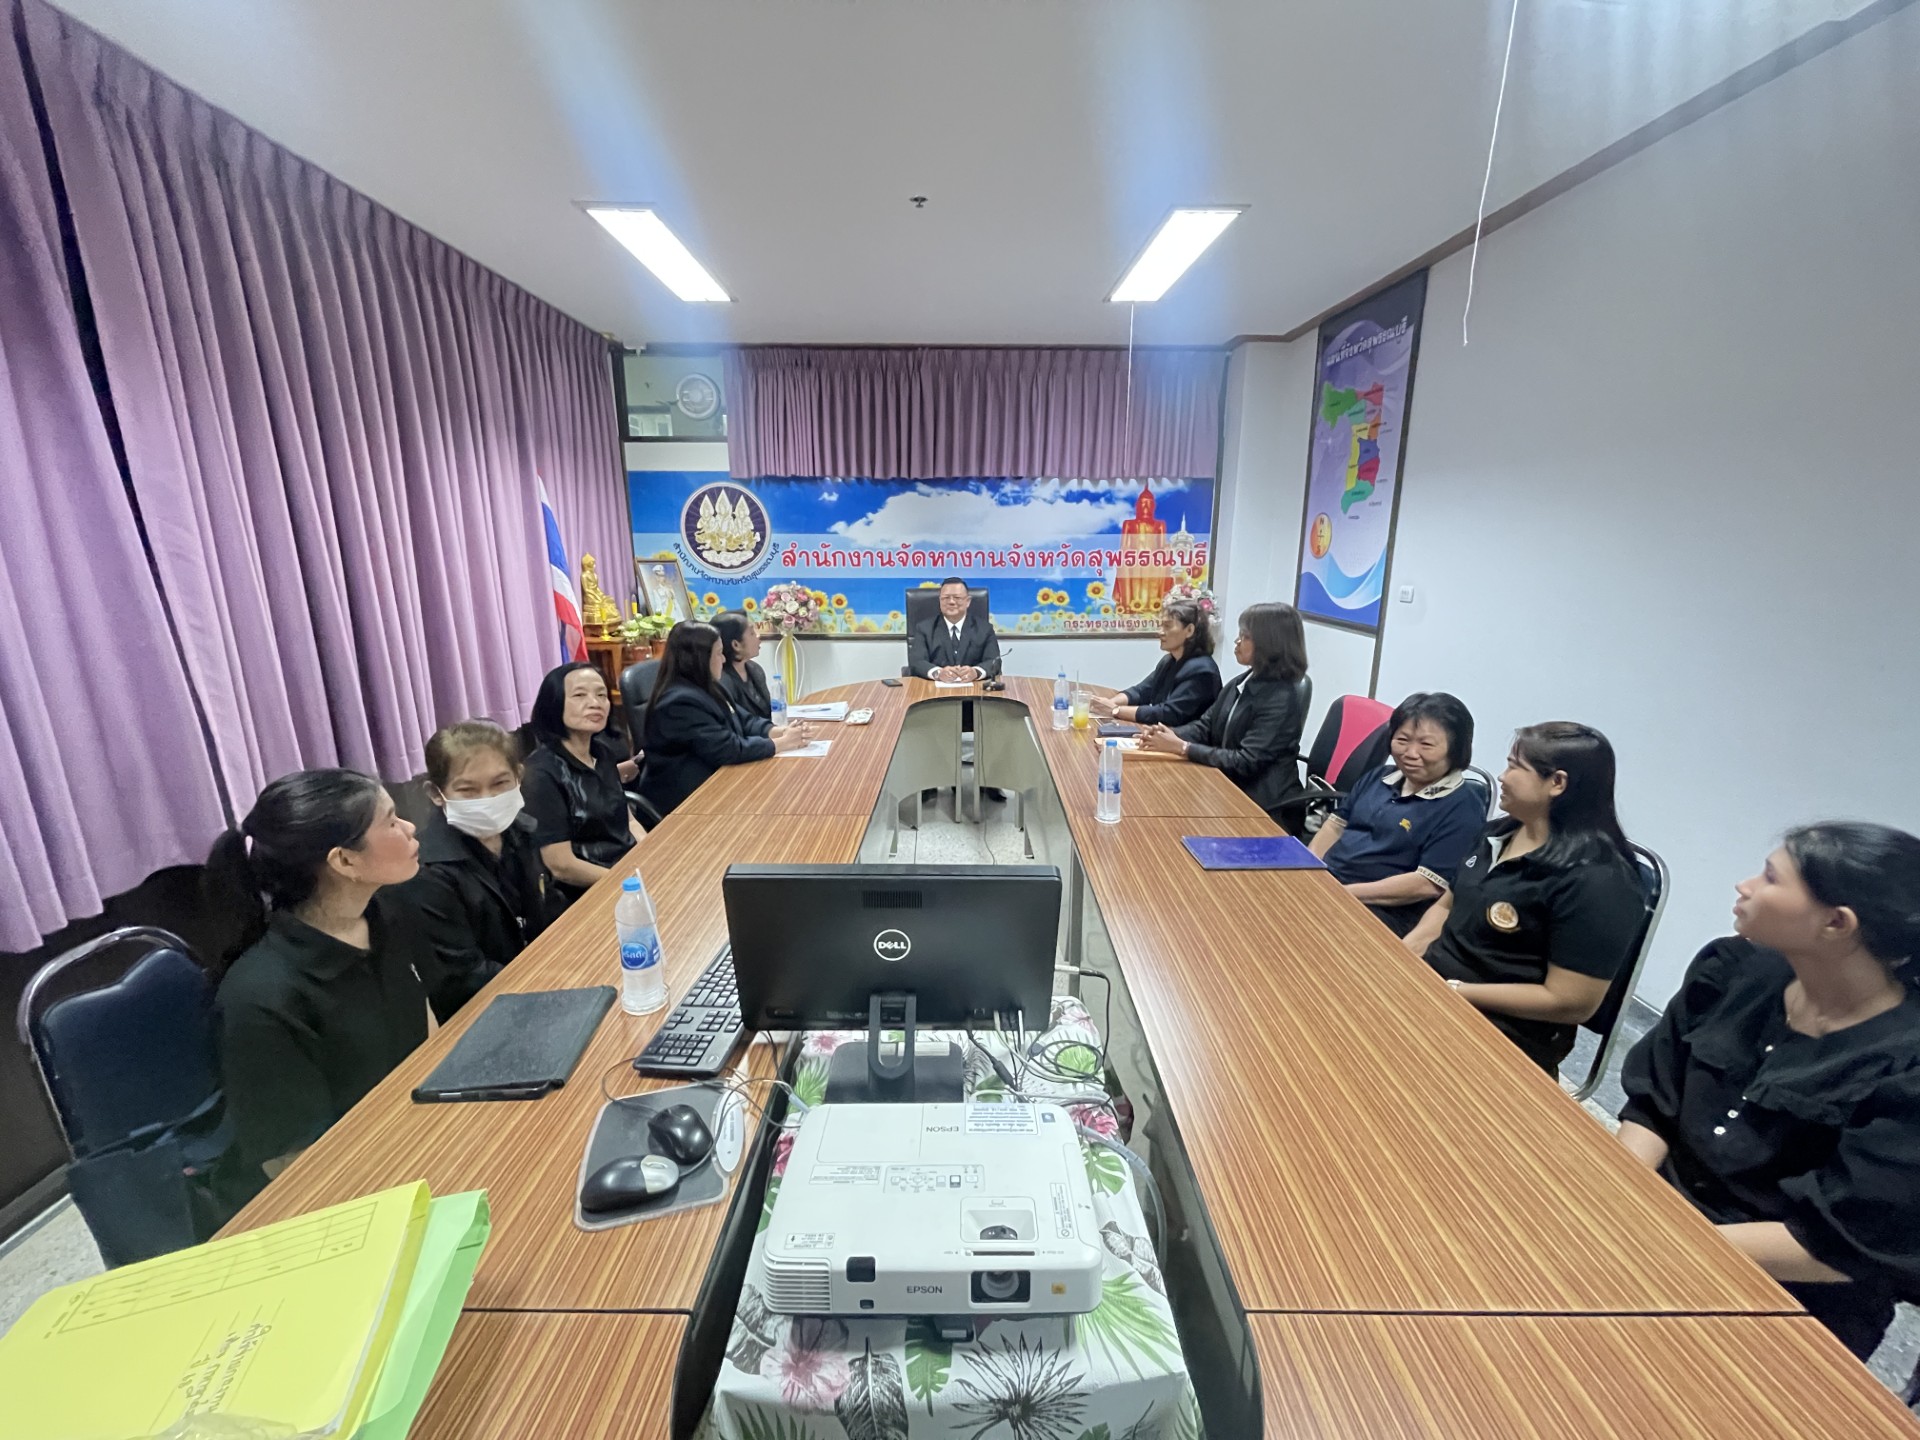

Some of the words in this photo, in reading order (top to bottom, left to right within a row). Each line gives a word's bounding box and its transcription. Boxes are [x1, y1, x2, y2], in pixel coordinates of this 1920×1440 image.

[782, 542, 1208, 576] สำนักงานจัดหางานจังหวัดสุพรรณบุรี
[878, 941, 907, 950] DELL
[926, 1125, 960, 1133] EPSON
[906, 1285, 943, 1294] EPSON
